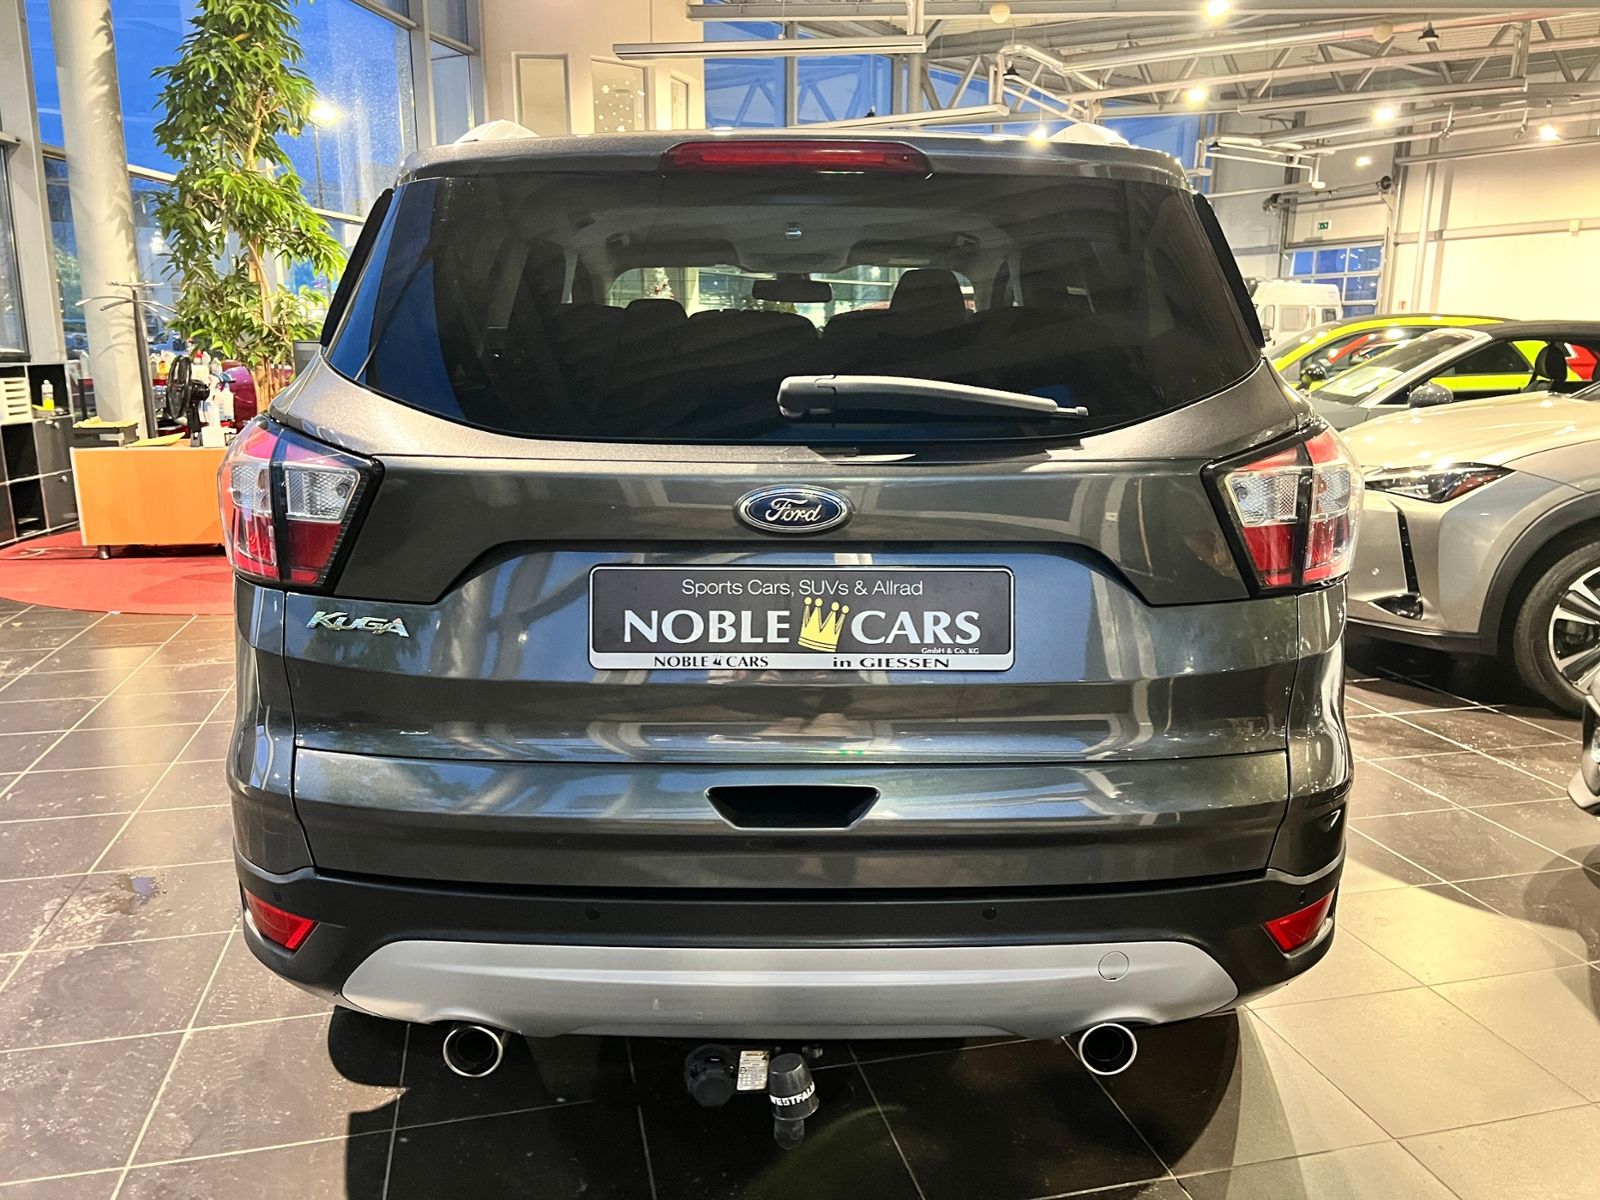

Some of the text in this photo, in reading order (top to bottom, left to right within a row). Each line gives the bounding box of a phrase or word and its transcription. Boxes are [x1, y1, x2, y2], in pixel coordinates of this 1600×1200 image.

[765, 497, 822, 522] Ford
[681, 579, 924, 598] Sports Cars, SUVs & Allrad
[306, 611, 410, 638] KUGA
[623, 609, 982, 645] NOBLE CARS
[654, 656, 769, 668] NOBLE CARS
[833, 657, 950, 669] in GIESSEN
